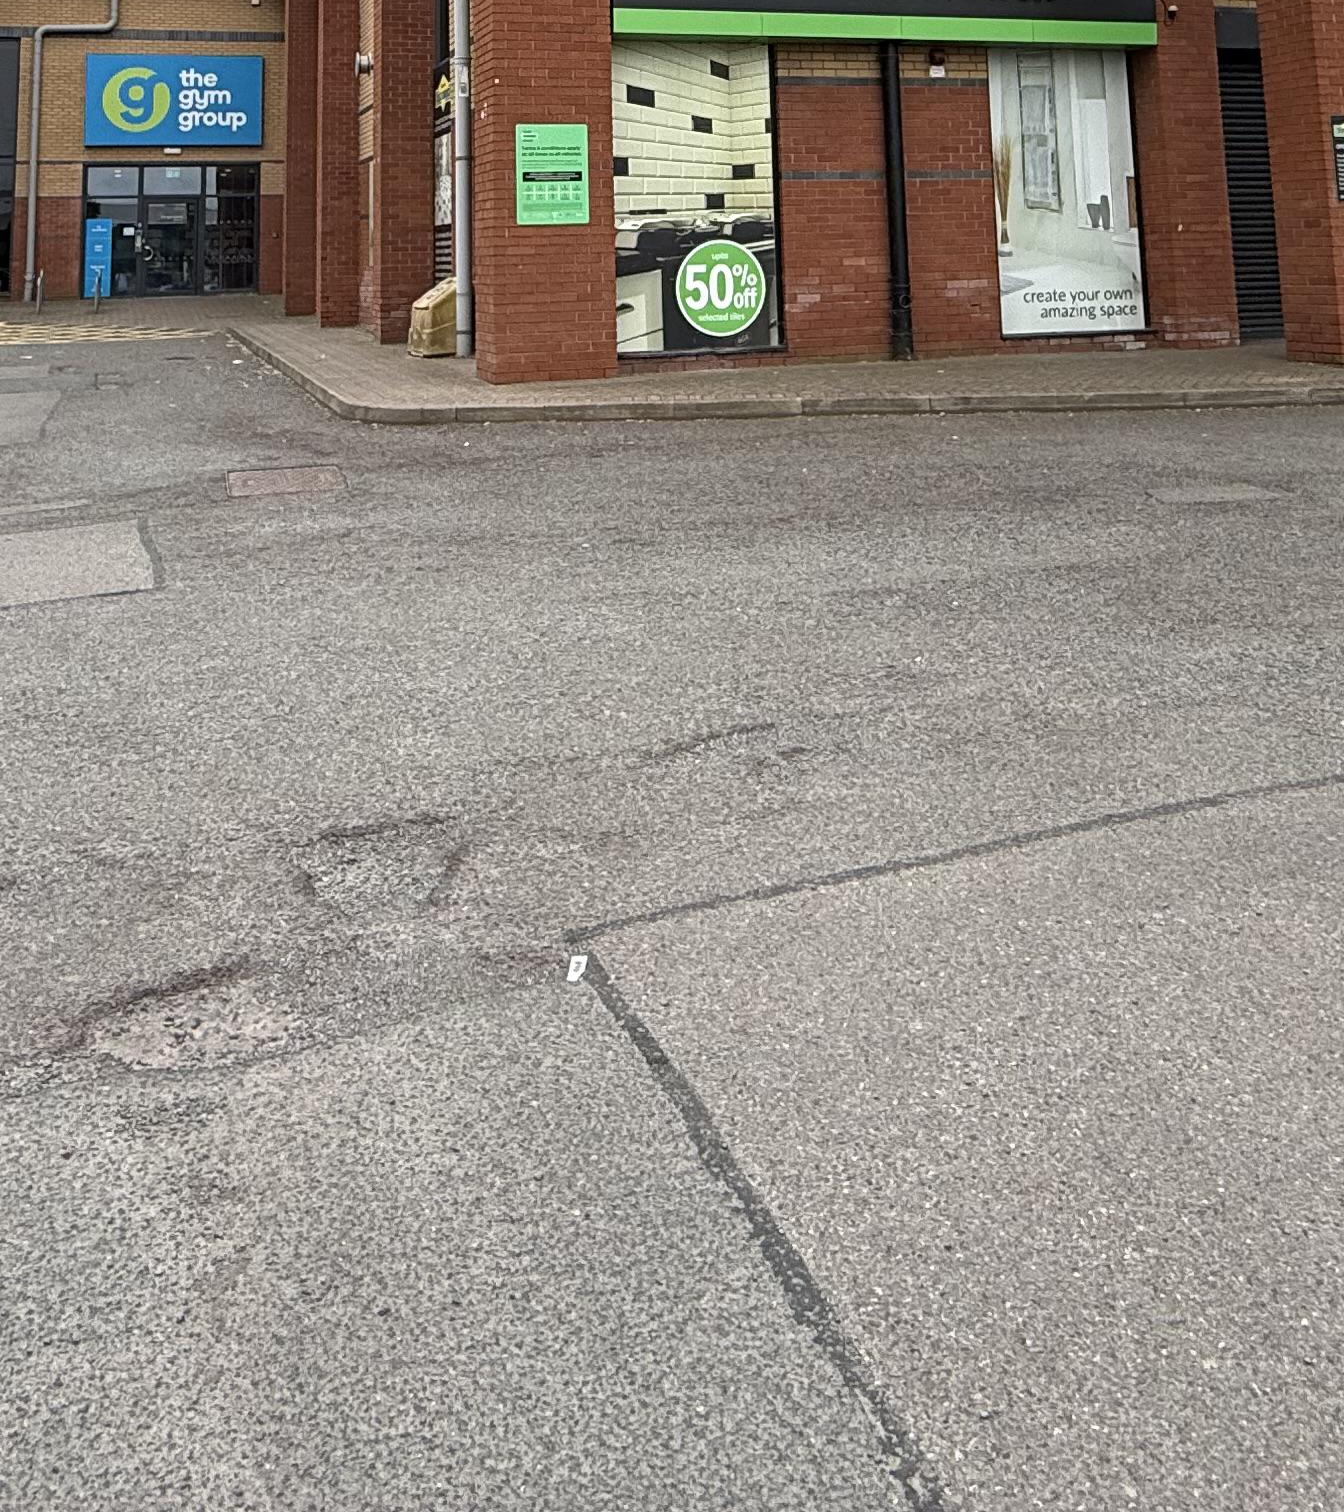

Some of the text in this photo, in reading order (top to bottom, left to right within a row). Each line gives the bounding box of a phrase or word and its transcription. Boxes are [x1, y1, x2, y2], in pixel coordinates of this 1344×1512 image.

[179, 68, 218, 87] the
[178, 88, 231, 110] gym
[178, 111, 247, 132] group
[685, 263, 757, 310] 50%
[1023, 289, 1133, 304] create your own
[733, 287, 757, 309] off
[698, 313, 745, 321] selected tiles
[1040, 304, 1137, 320] amazing space
